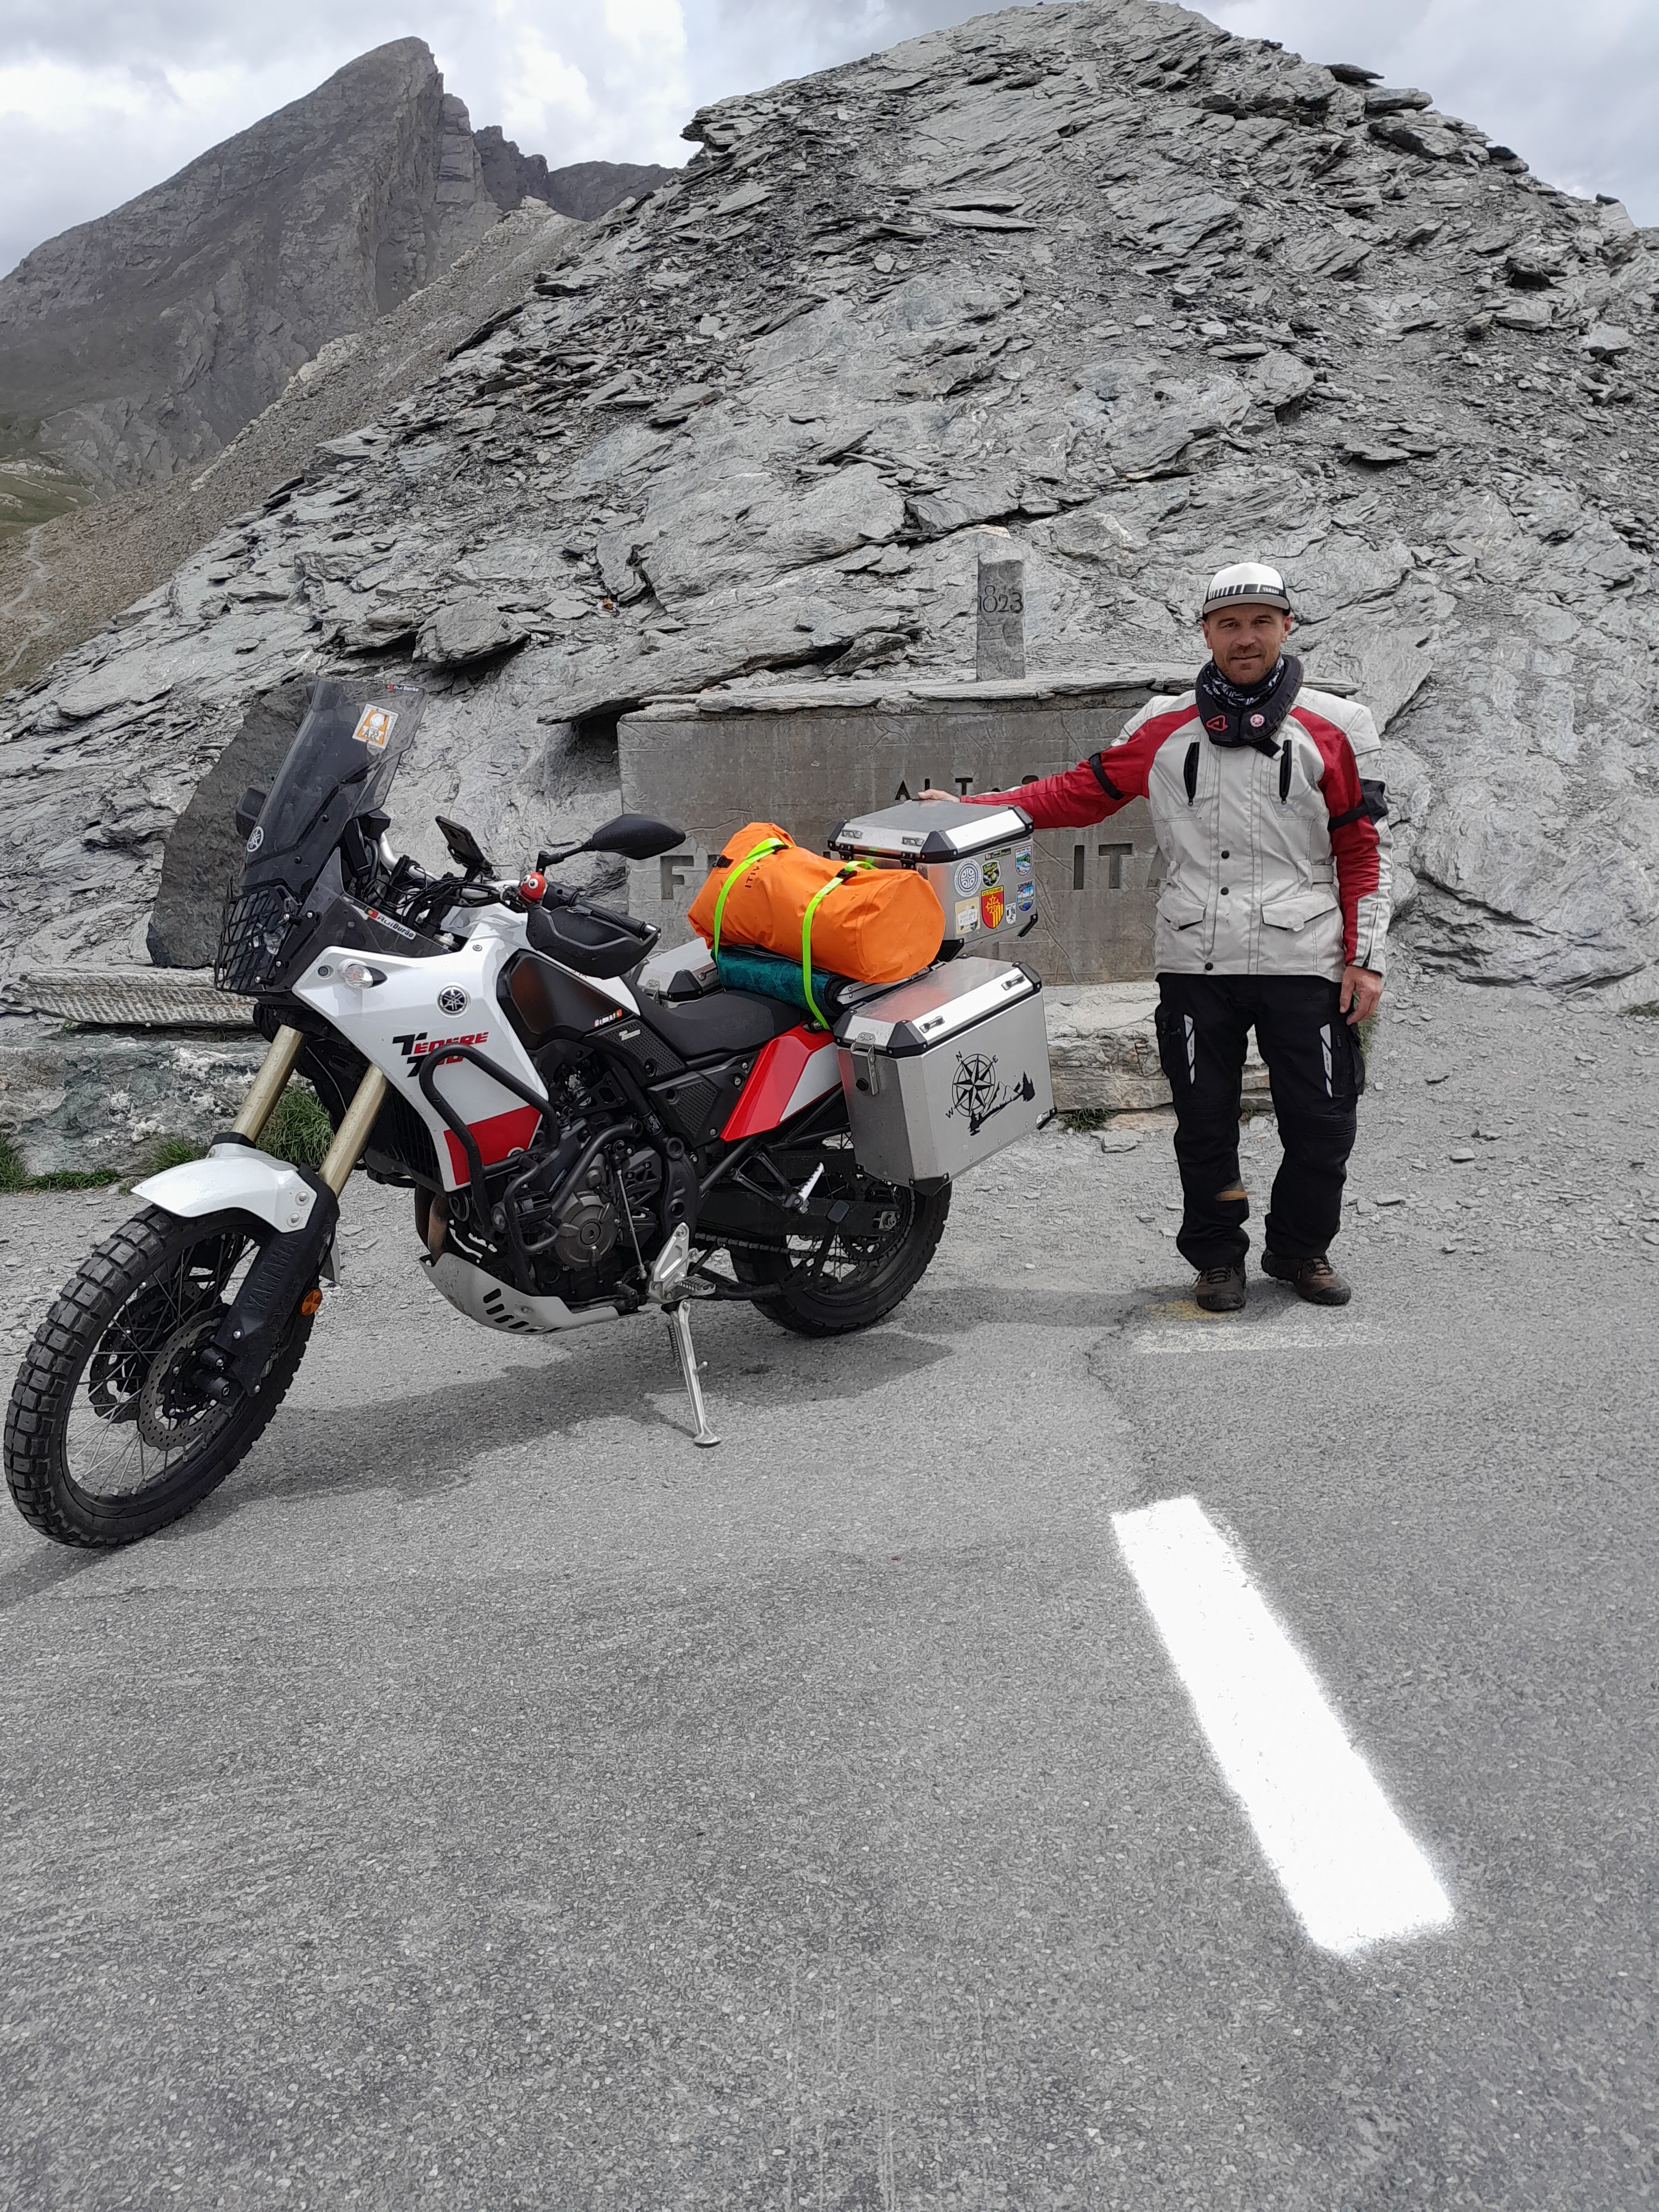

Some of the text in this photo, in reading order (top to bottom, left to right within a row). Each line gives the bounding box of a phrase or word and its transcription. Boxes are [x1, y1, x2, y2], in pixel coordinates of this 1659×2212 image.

[979, 585, 1024, 614] 1823
[956, 1051, 962, 1062] N
[992, 1054, 999, 1063] E
[945, 1107, 954, 1118] W
